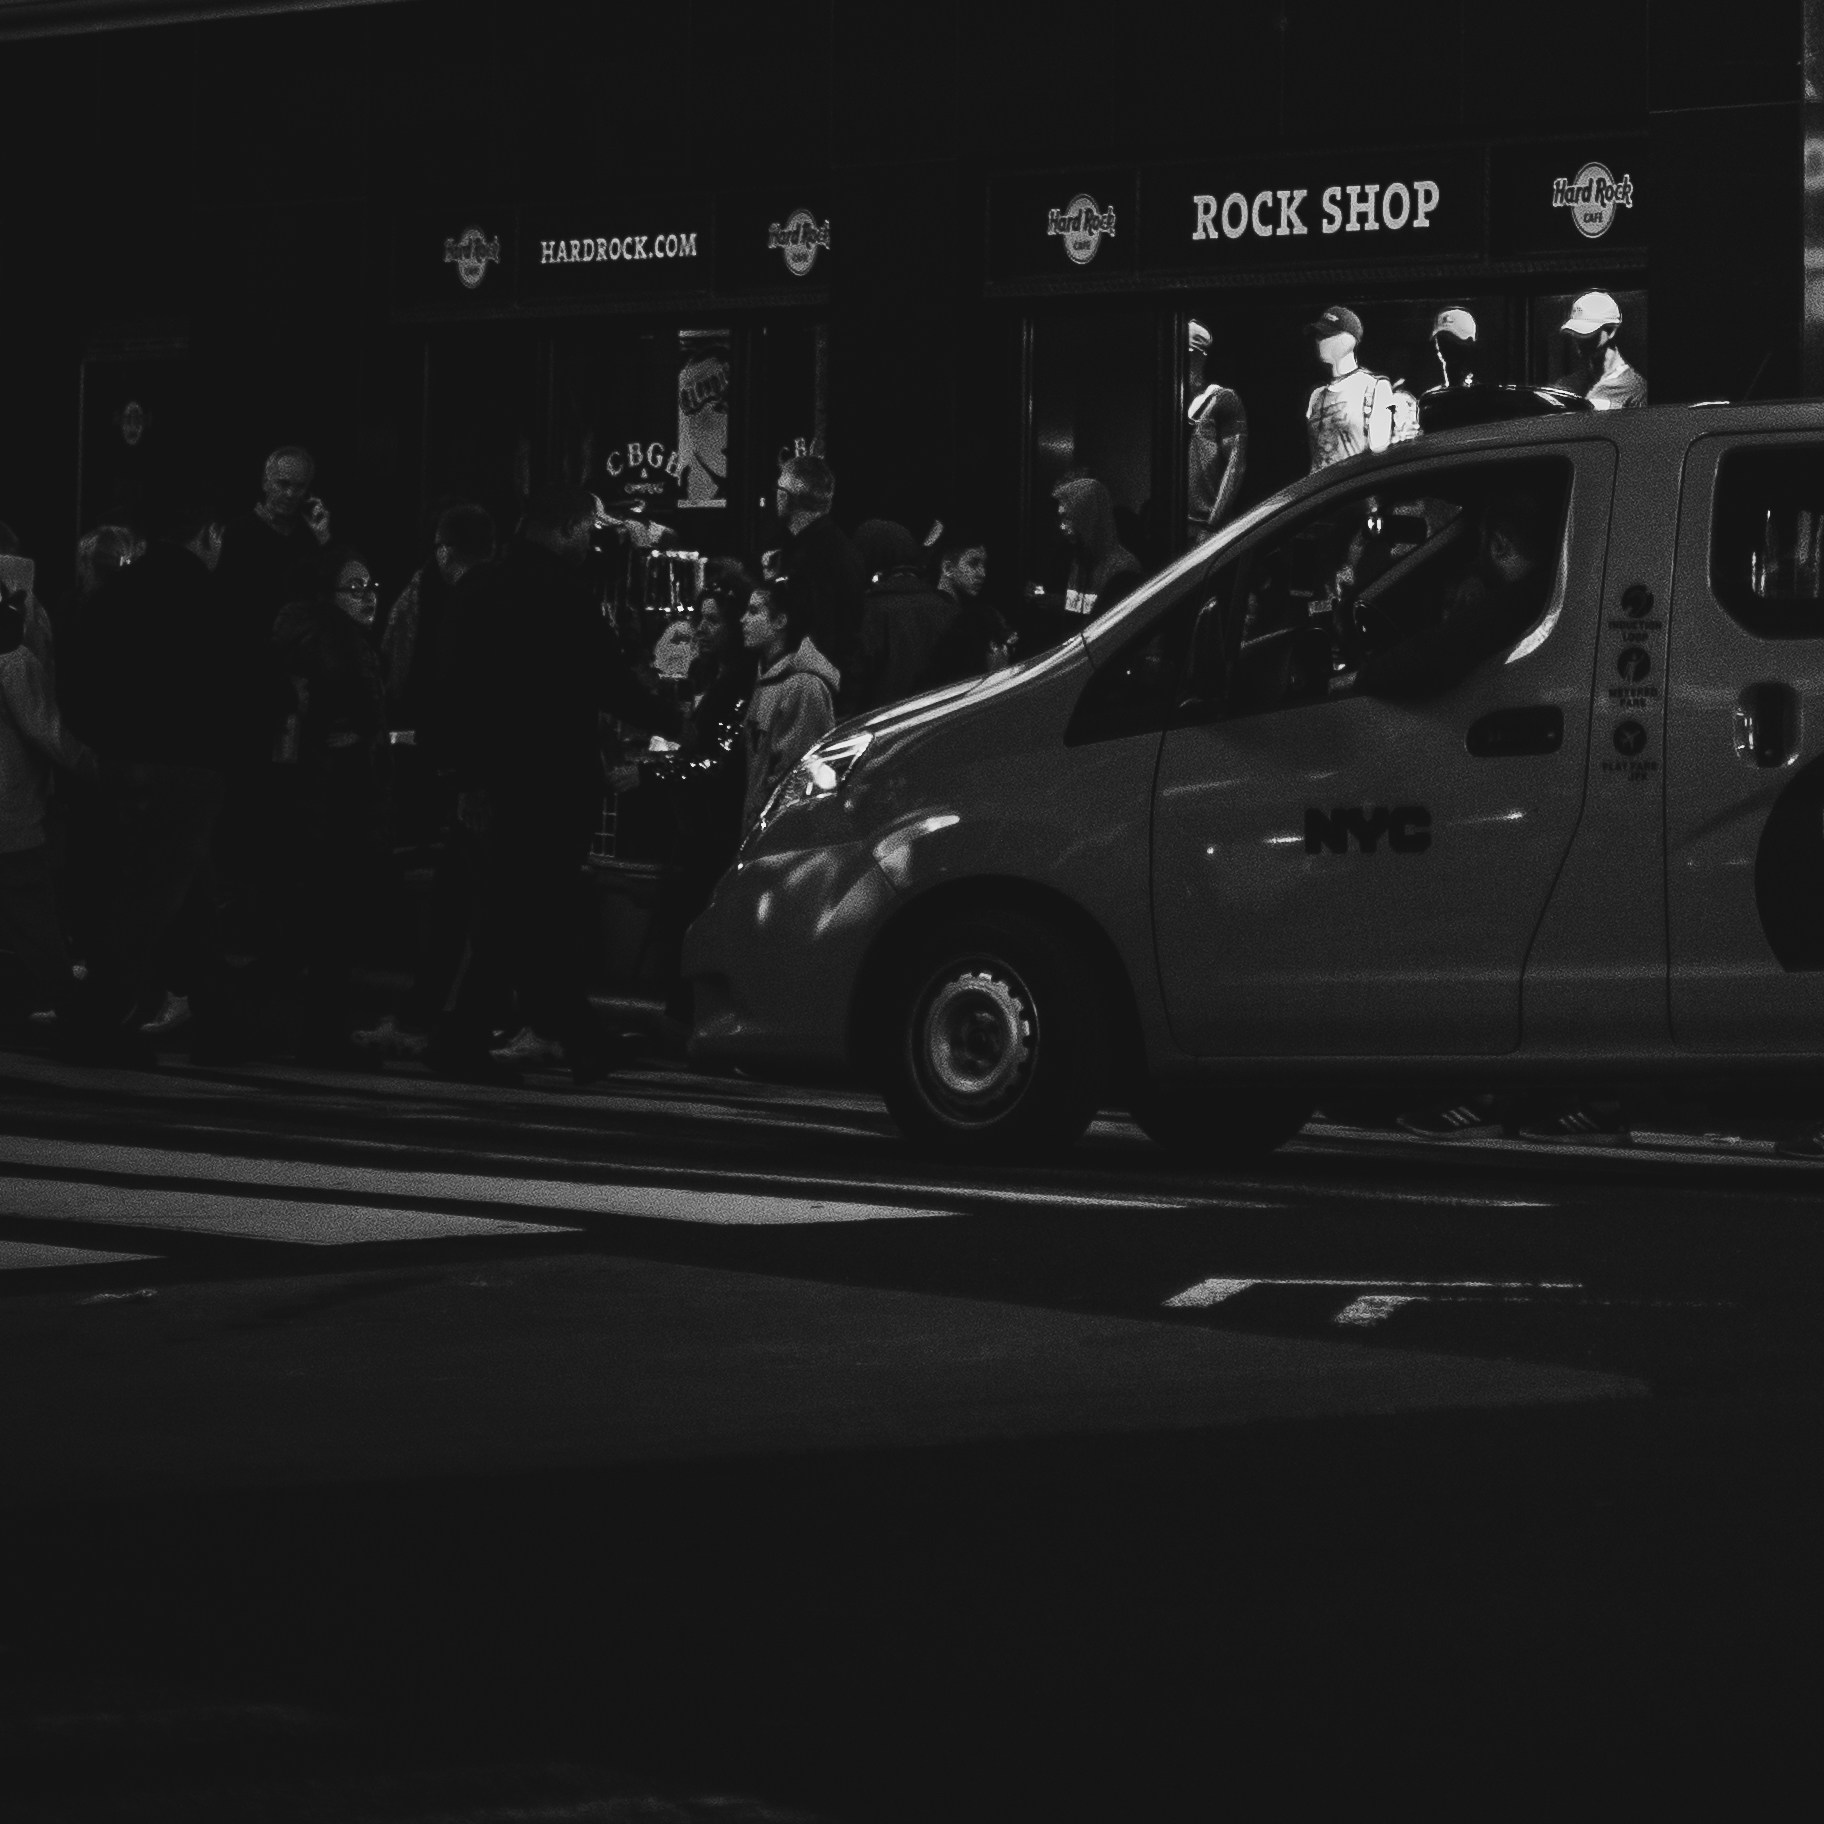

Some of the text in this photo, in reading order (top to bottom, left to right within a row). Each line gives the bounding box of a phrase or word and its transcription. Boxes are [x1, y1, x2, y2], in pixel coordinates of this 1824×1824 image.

[1553, 173, 1634, 209] Hard Rock
[1047, 206, 1117, 239] Hard Rock
[1191, 180, 1440, 241] ROCK SHOP
[1582, 212, 1604, 224] CAFE
[540, 233, 698, 265] HARDROCK.COM
[1303, 804, 1433, 855] NYC
